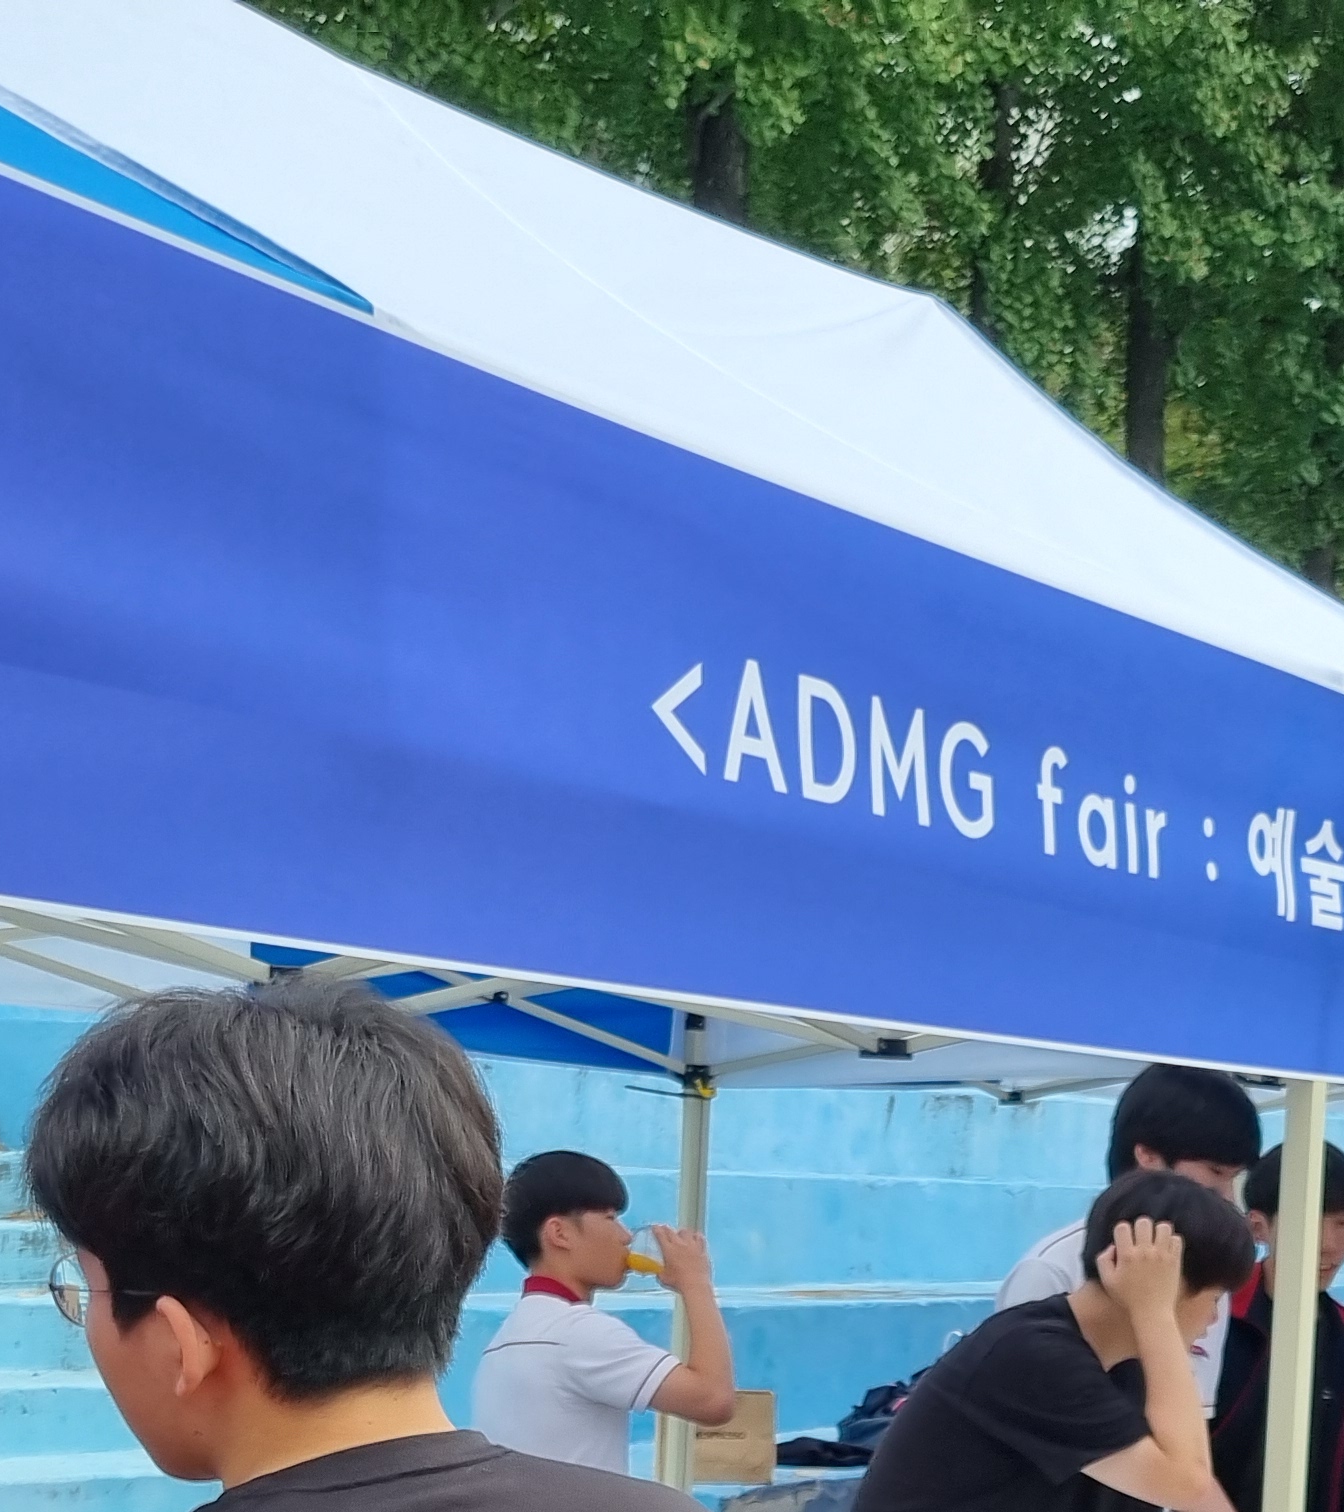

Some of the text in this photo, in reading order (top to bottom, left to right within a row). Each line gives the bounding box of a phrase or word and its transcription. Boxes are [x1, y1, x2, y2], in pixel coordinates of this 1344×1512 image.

[650, 657, 996, 841] <ADMG
[1036, 745, 1167, 880] fair
[1202, 816, 1220, 883] :
